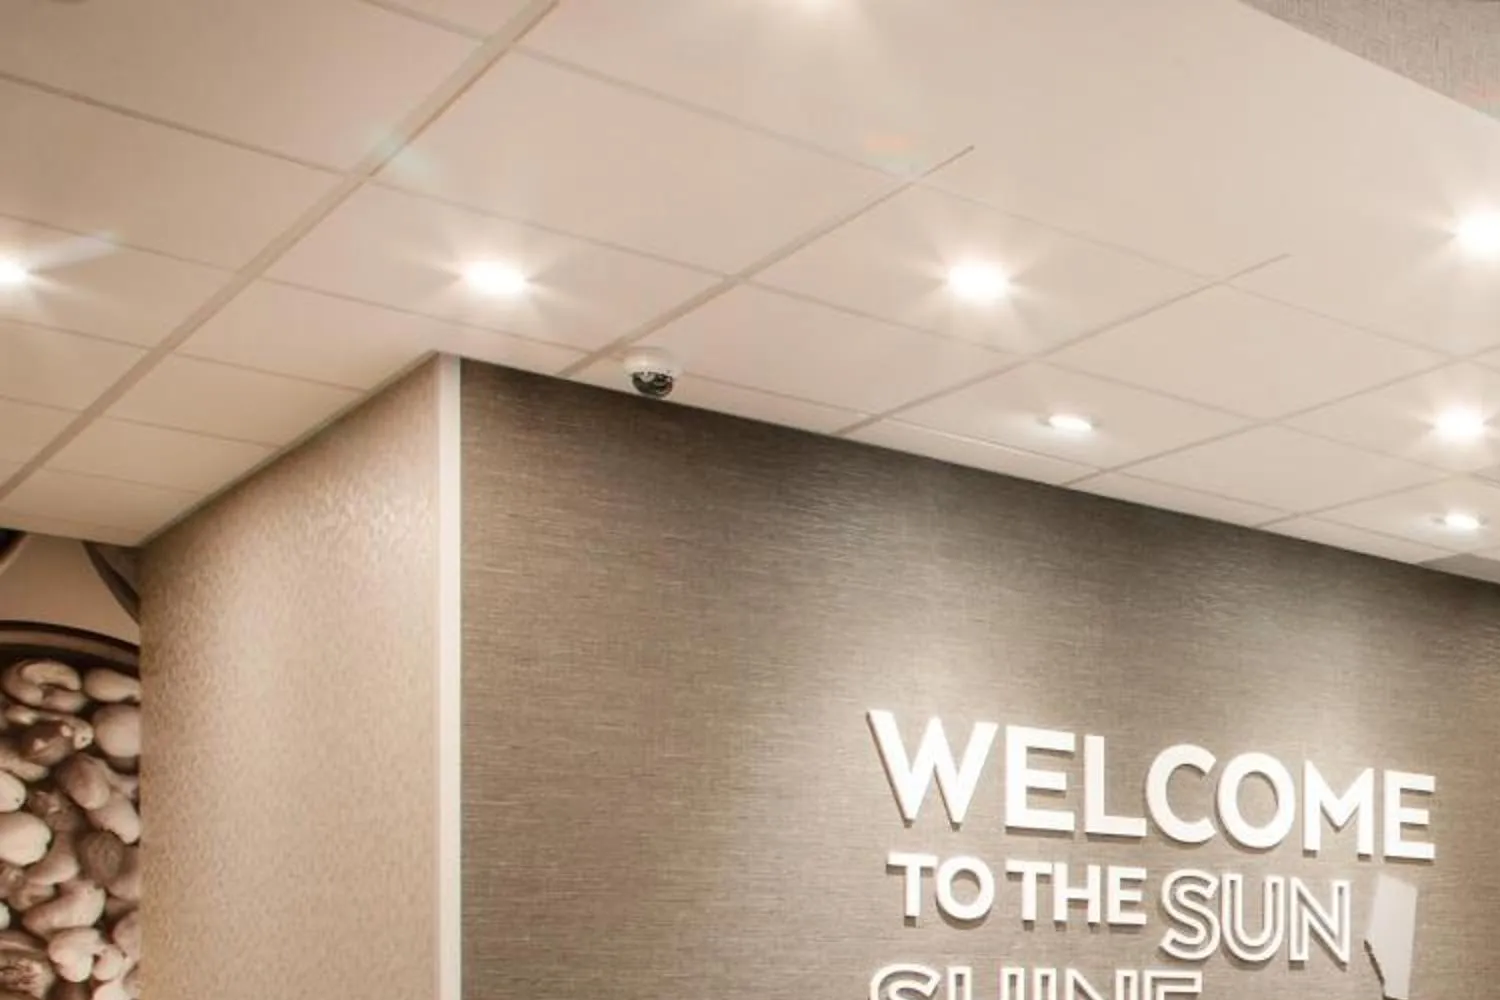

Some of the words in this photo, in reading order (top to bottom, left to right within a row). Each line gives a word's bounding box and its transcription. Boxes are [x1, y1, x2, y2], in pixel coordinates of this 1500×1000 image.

[867, 708, 1436, 860] WELCOME
[887, 852, 995, 922] TO
[1005, 858, 1148, 926] THE
[1160, 867, 1351, 963] SUN
